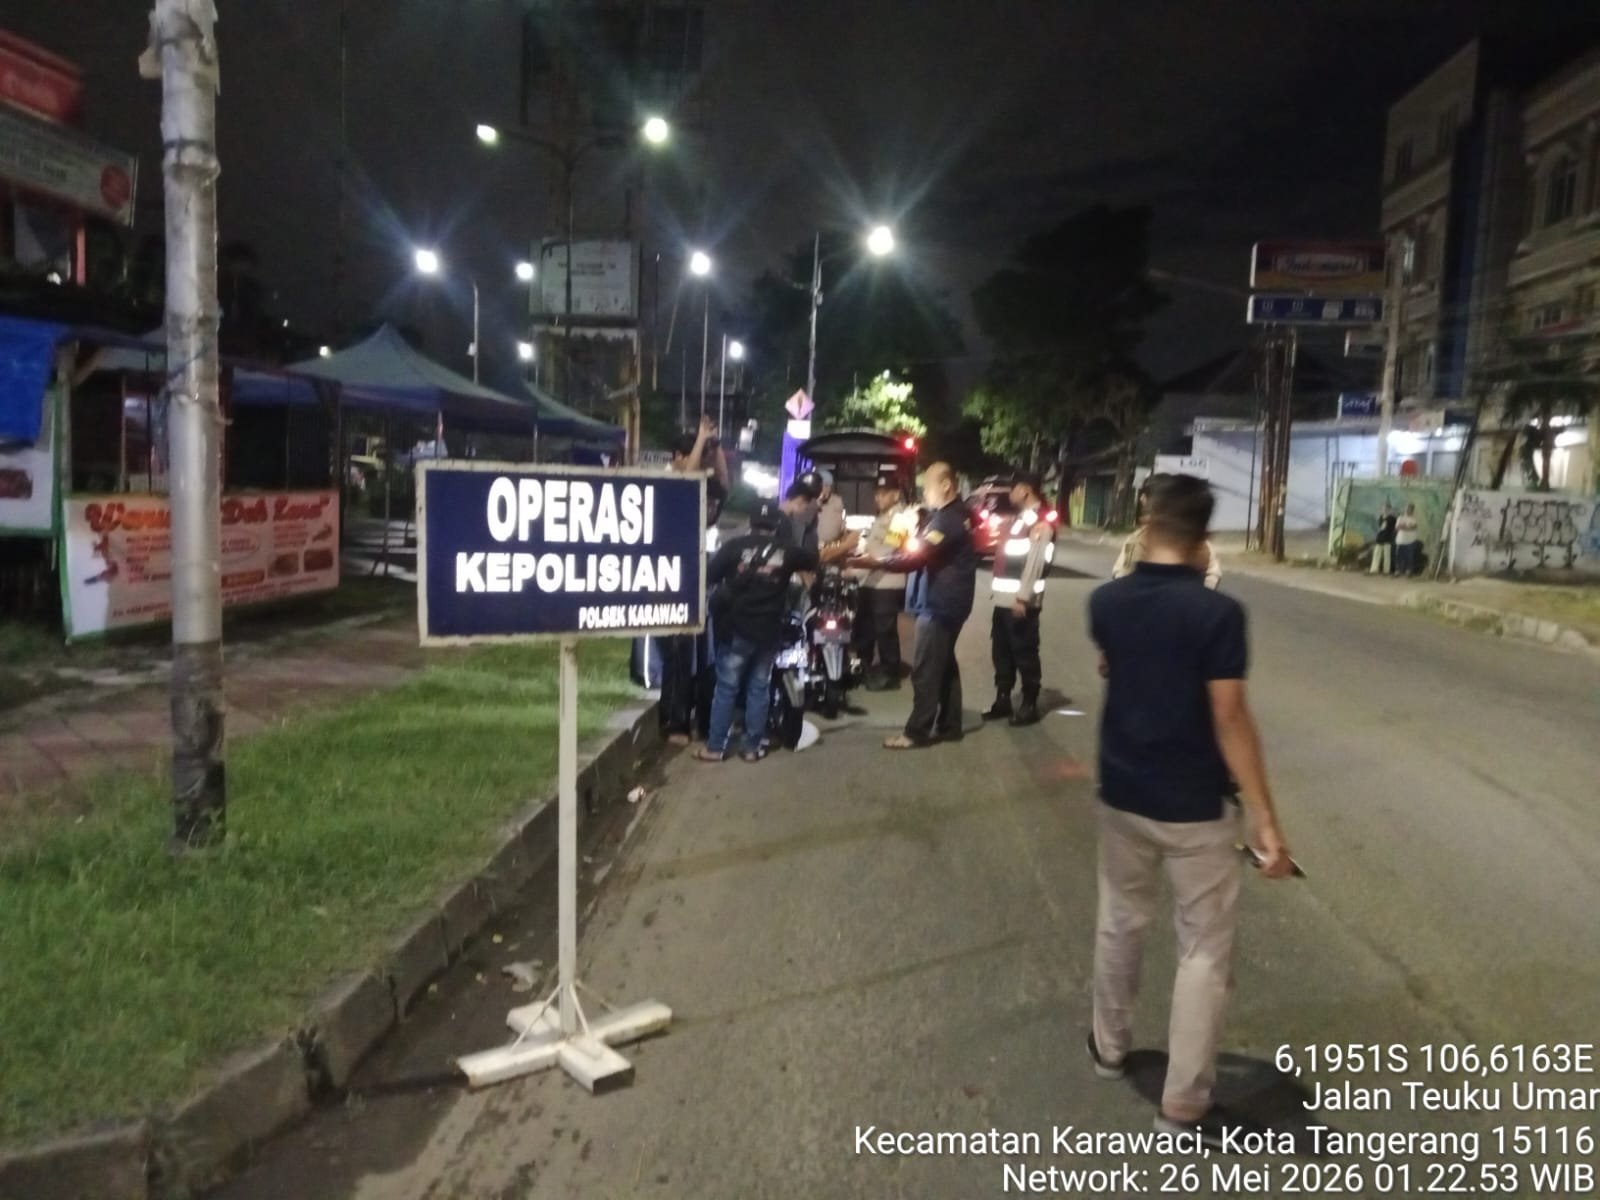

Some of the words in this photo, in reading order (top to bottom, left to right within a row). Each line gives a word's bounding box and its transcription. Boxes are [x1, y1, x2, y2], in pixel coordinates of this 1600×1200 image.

[487, 477, 654, 544] OPERASI
[456, 552, 681, 592] KEPOLISIAN
[578, 606, 626, 630] POLSEK
[628, 603, 688, 626] KARAWACI
